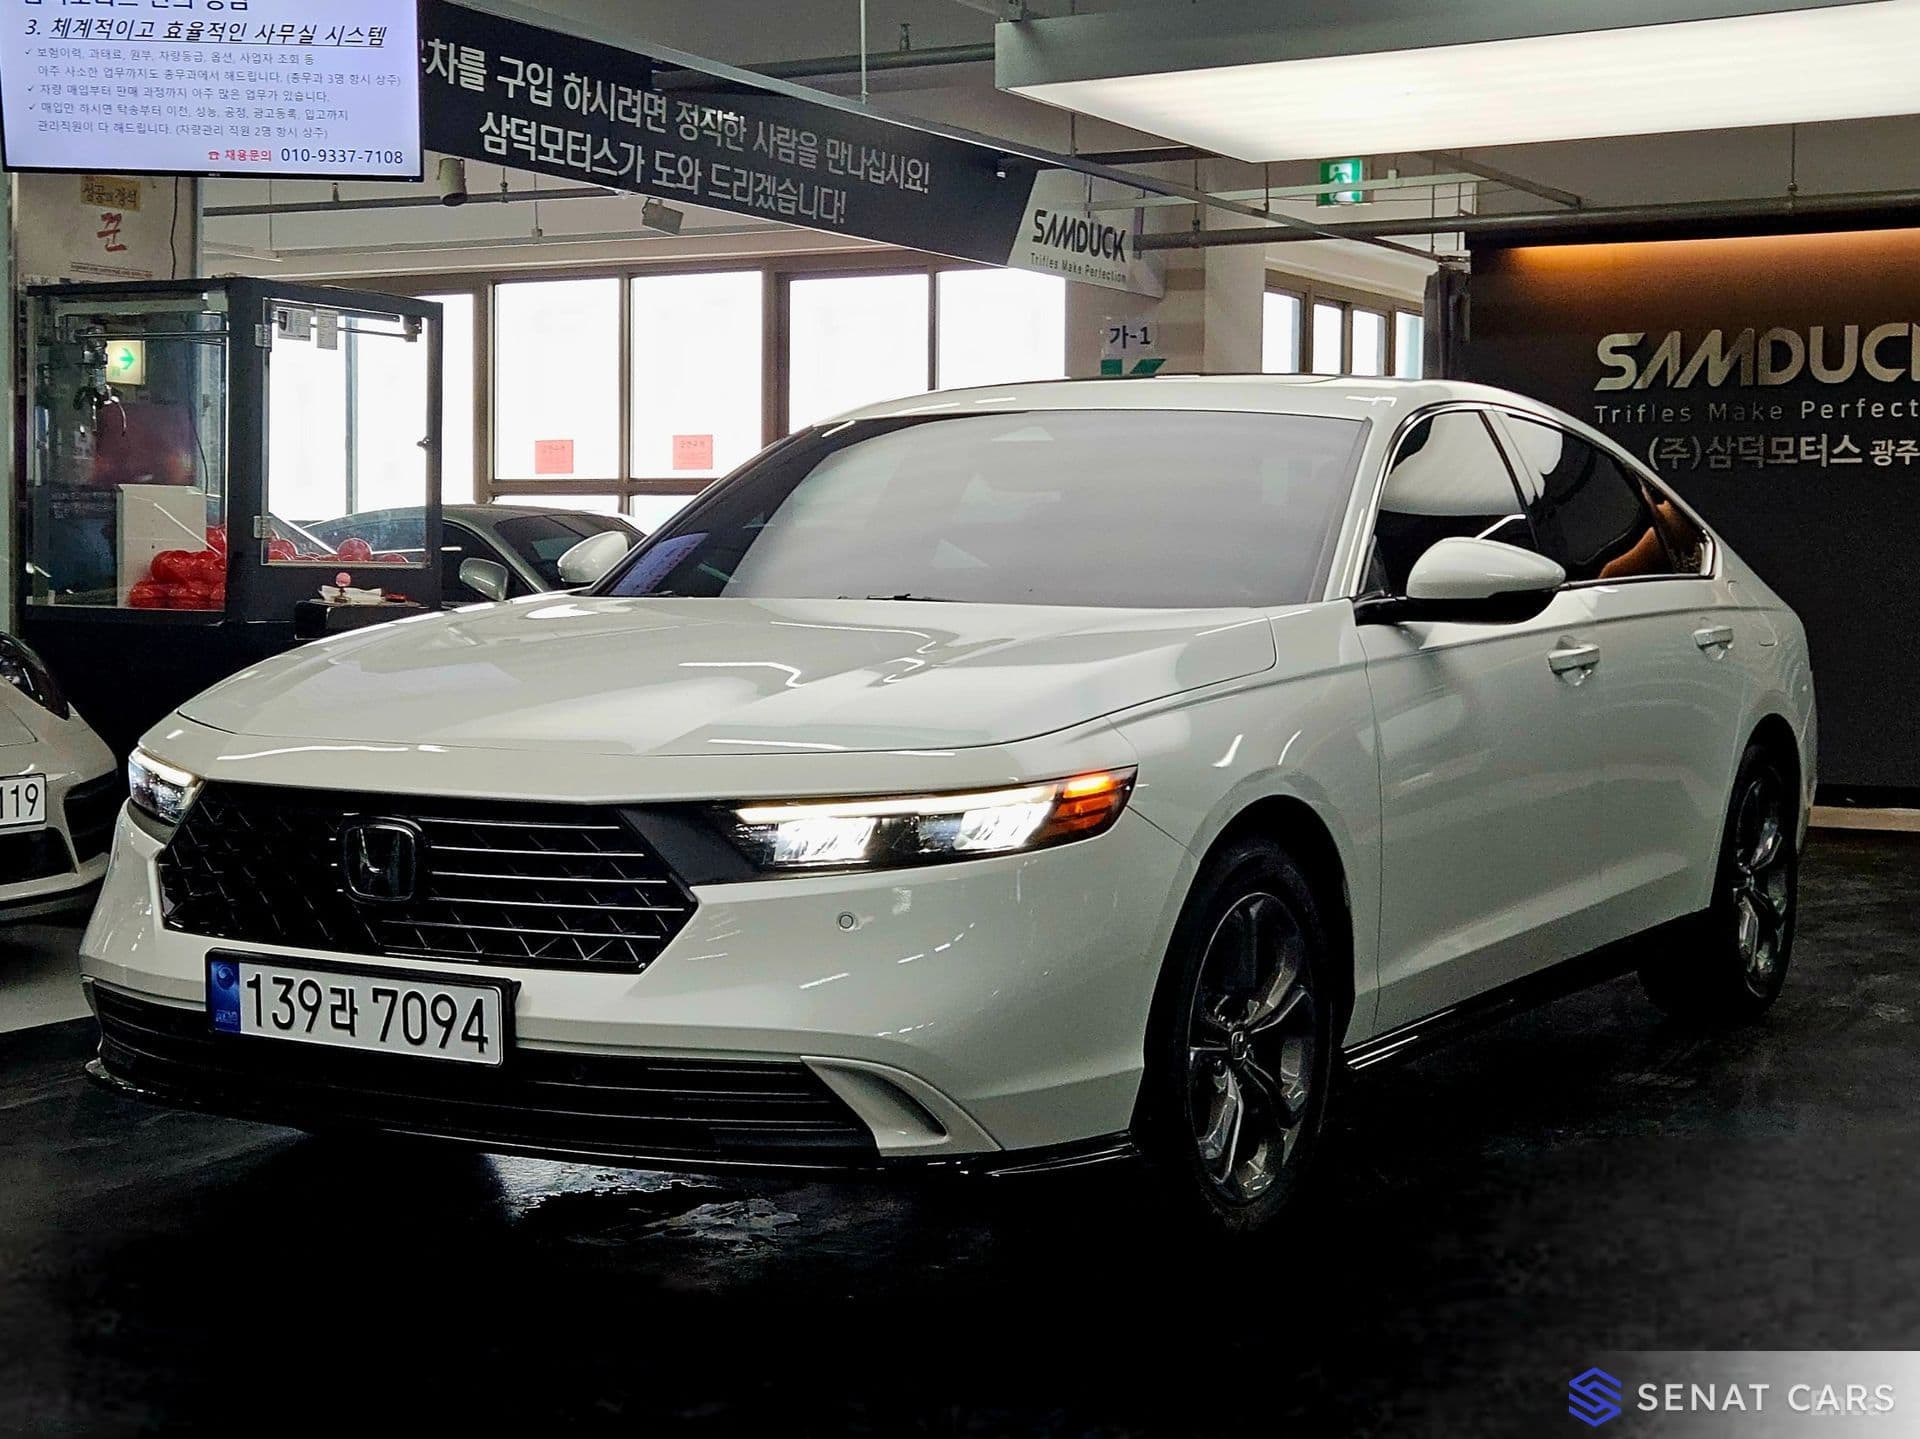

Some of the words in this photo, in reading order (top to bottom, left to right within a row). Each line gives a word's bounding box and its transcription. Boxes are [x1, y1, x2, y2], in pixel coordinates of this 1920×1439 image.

[25, 19, 41, 35] 3.
[51, 17, 154, 40] 체계적이고
[163, 20, 247, 42] 효율적인
[255, 24, 317, 45] 사무실
[325, 25, 387, 47] 시스템
[240, 52, 272, 64] 사업자
[277, 54, 299, 64] 조회
[38, 65, 60, 77] 아주
[103, 67, 159, 79] 업무까지도
[192, 88, 214, 100] 아주
[98, 121, 108, 133] 다
[421, 38, 487, 92] 차를
[497, 54, 553, 107] 구입
[564, 71, 667, 133] 하시려면
[676, 100, 746, 152] 정직한
[752, 119, 819, 174] 사람을
[825, 137, 929, 194] 만나십시요!
[224, 149, 272, 162] 채용문의
[281, 148, 403, 164] 010-9337-7108
[479, 111, 644, 184] 삼덕모터스가
[652, 148, 702, 195] 도와
[708, 165, 846, 224] 드리겠습니다!
[1032, 209, 1126, 263] SAMDUCK
[1109, 326, 1151, 349] 가-1
[1594, 402, 1692, 424] Trifles
[1708, 401, 1783, 423] Make
[1650, 433, 1863, 471] (주)삼덕모터스
[246, 973, 358, 1038] 139라
[372, 987, 488, 1054] 7094
